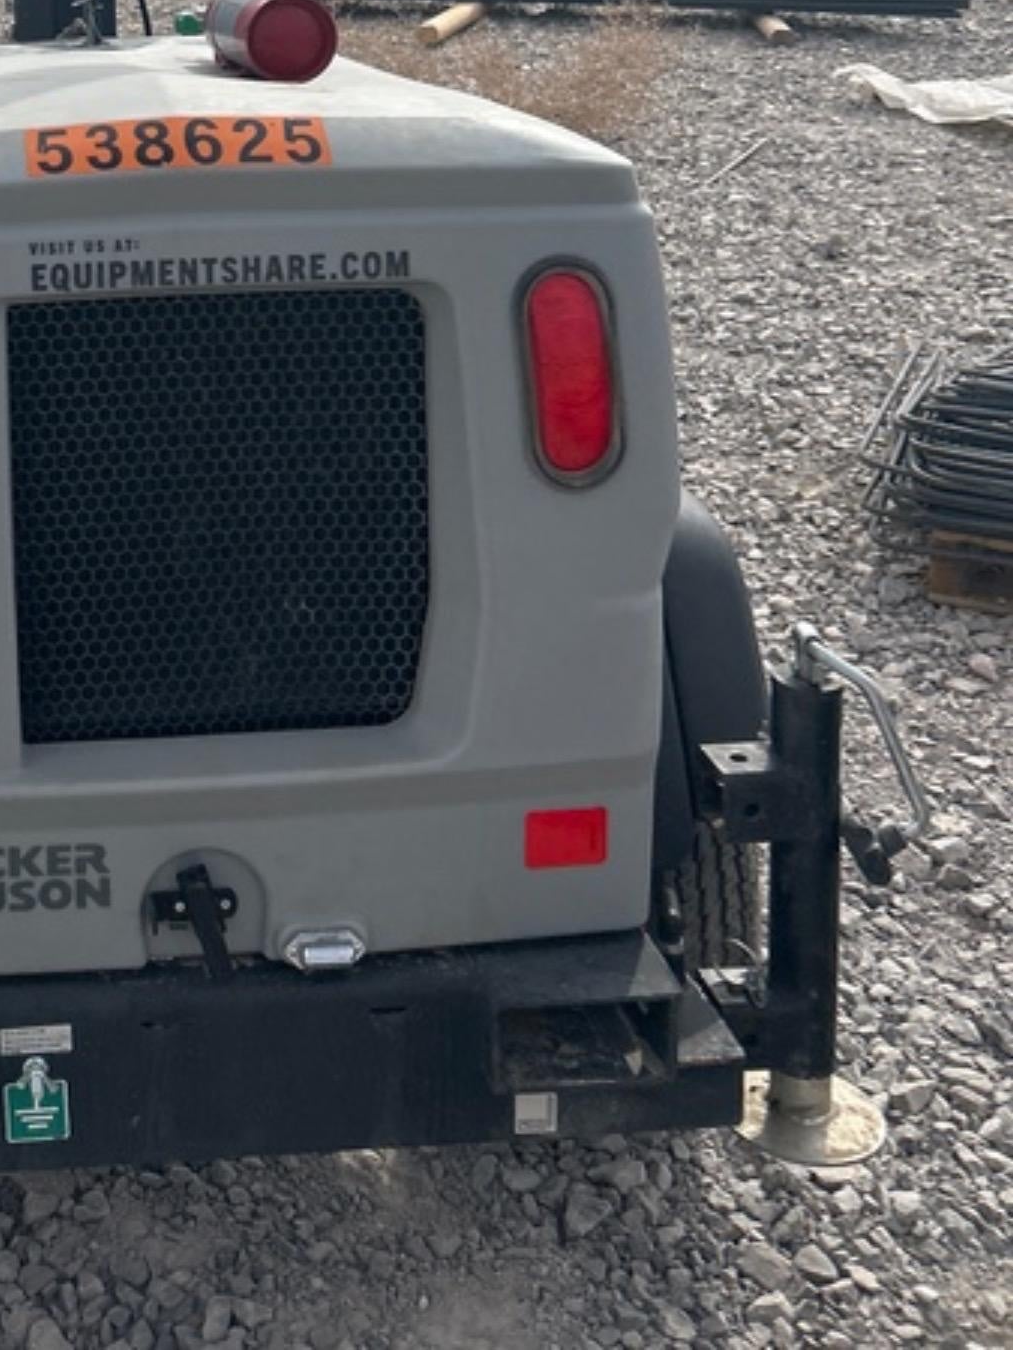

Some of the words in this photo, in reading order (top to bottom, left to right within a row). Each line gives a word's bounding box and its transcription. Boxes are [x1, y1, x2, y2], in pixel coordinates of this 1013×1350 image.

[36, 117, 323, 174] 538625
[29, 240, 75, 256] VISIT
[84, 239, 106, 253] US
[114, 238, 140, 252] AT:
[32, 251, 409, 291] EQUIPMENTSHARE.COM
